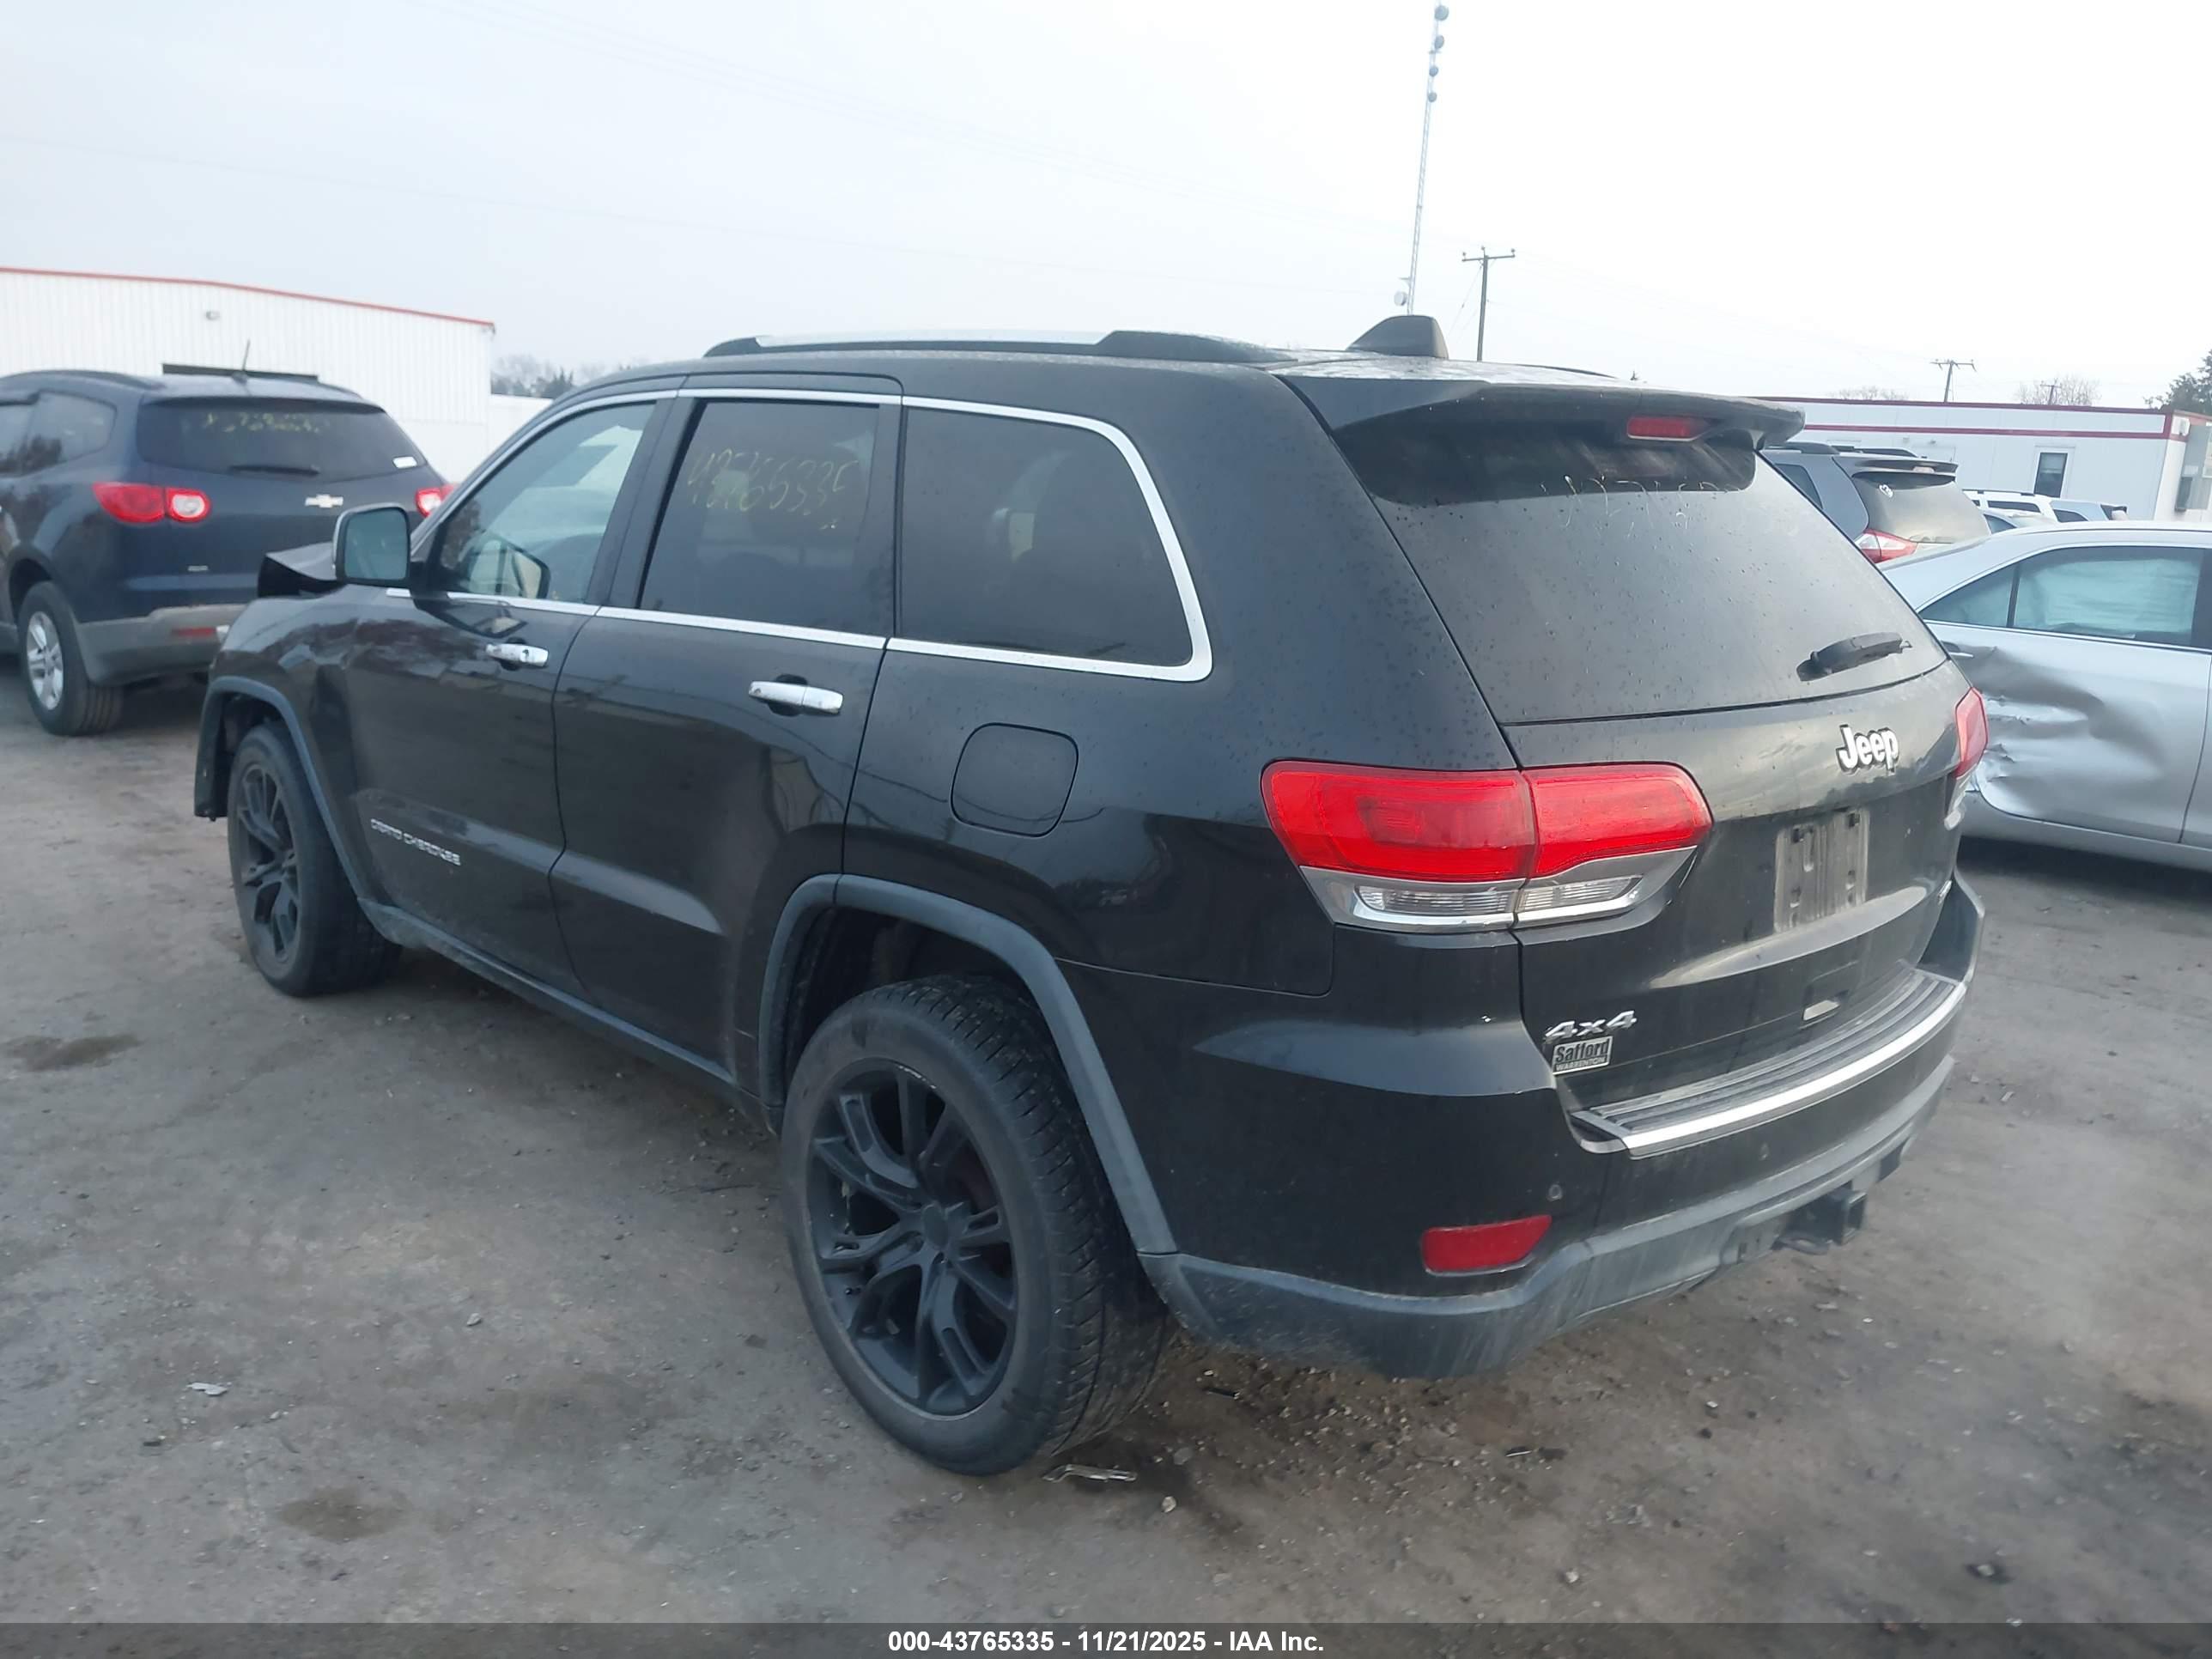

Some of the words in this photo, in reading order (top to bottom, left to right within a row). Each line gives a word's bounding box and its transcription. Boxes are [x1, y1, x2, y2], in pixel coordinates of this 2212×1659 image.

[1836, 724, 1899, 773] Jeep
[1545, 1010, 1638, 1038] 4x4
[1555, 1038, 1609, 1063] Safford
